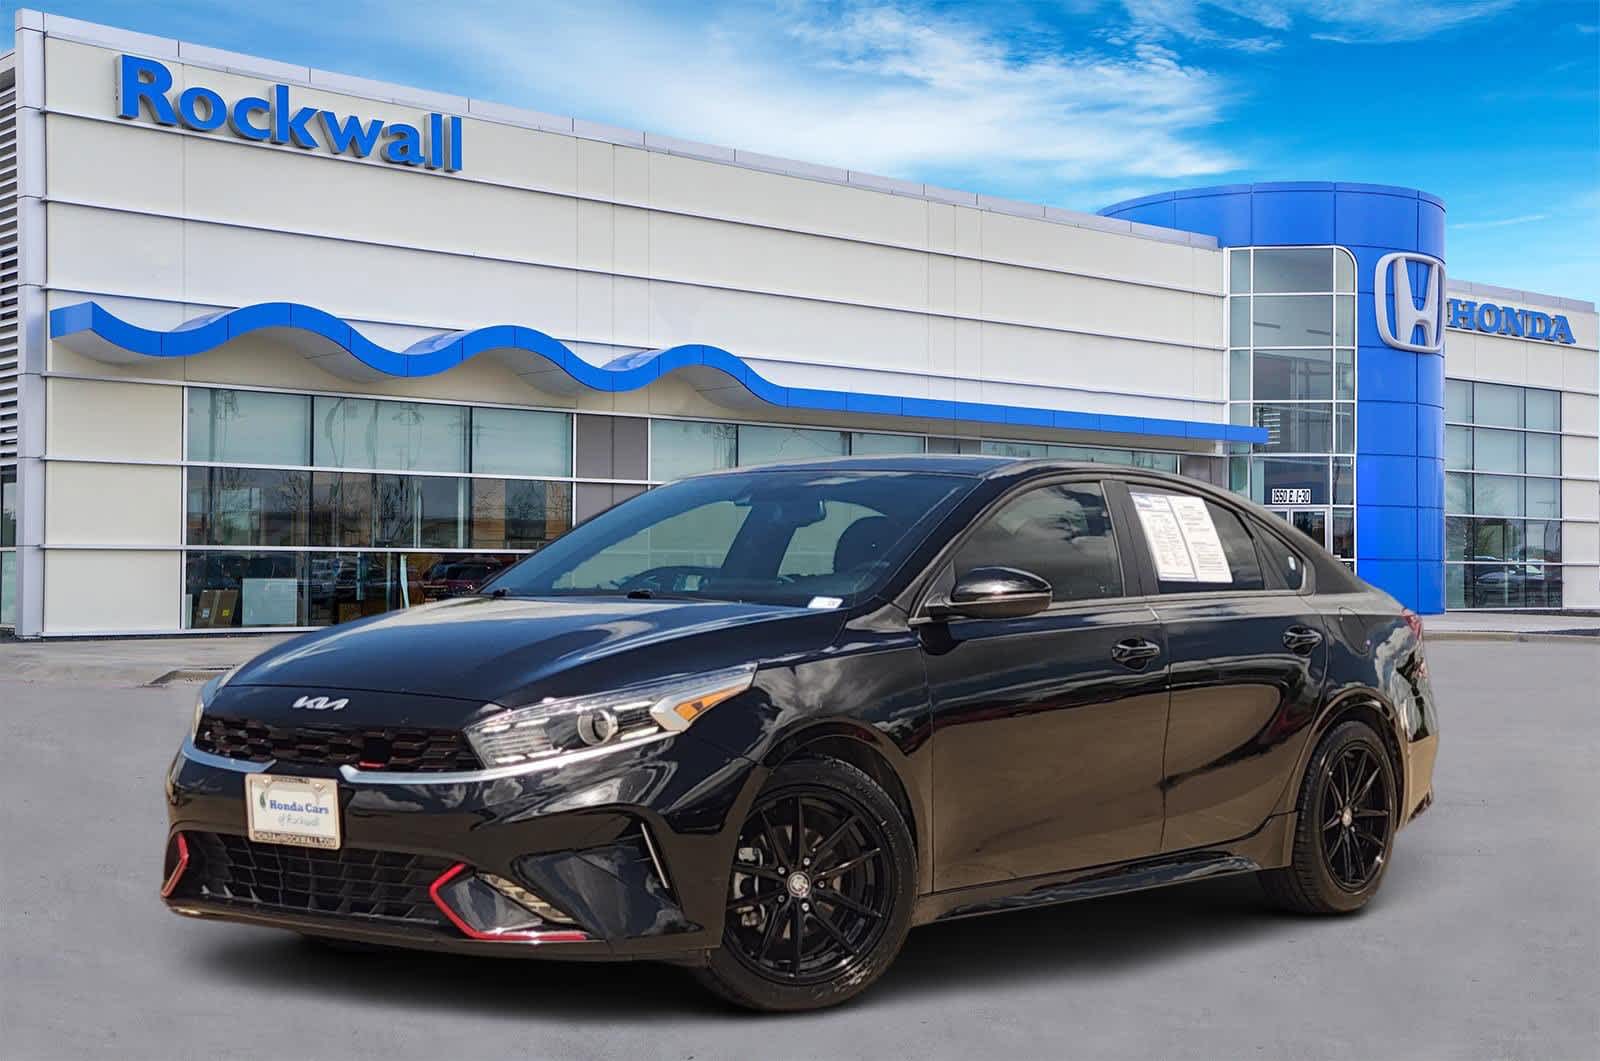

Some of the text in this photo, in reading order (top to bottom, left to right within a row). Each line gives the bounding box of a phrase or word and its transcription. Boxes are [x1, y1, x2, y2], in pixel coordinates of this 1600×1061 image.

[117, 53, 463, 172] Rockwall
[1448, 299, 1576, 344] HONDA
[1273, 490, 1288, 503] 1550
[269, 799, 329, 814] Honda Cars
